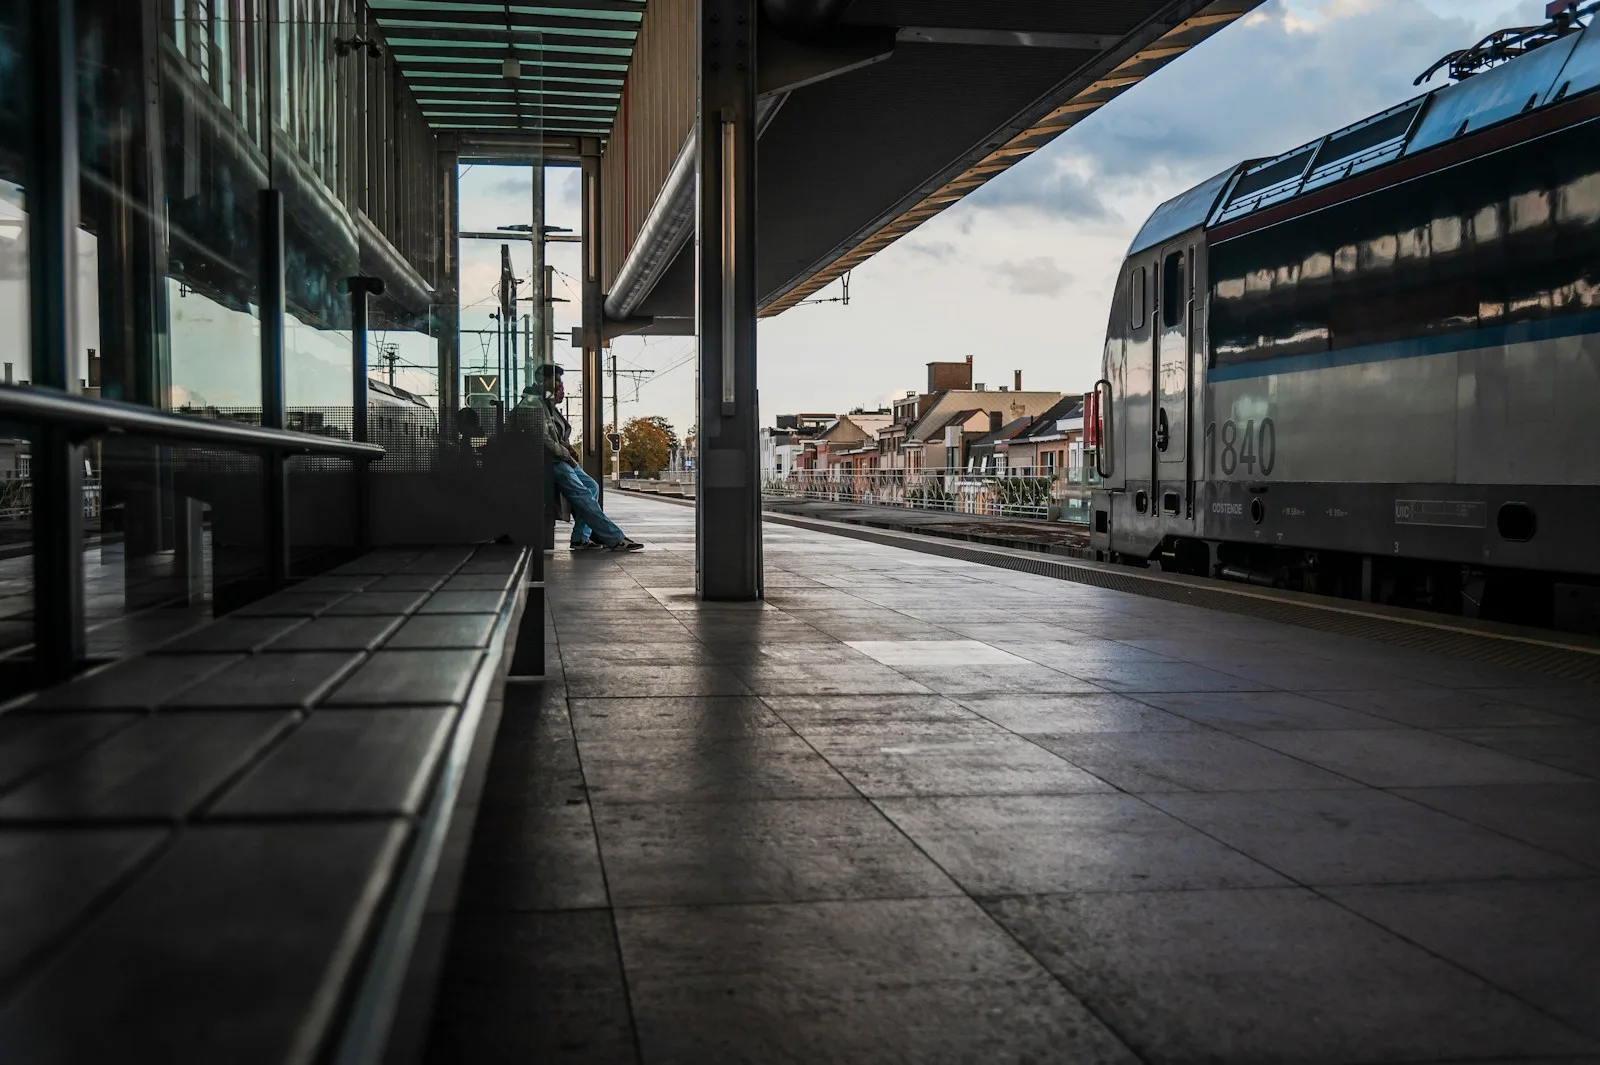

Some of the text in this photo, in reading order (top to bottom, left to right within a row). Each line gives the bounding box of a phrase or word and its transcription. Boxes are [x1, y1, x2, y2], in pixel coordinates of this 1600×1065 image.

[1206, 417, 1276, 476] 1840
[1211, 502, 1243, 515] OOSTENDE
[1395, 505, 1409, 518] UIC
[1393, 541, 1399, 554] 3
